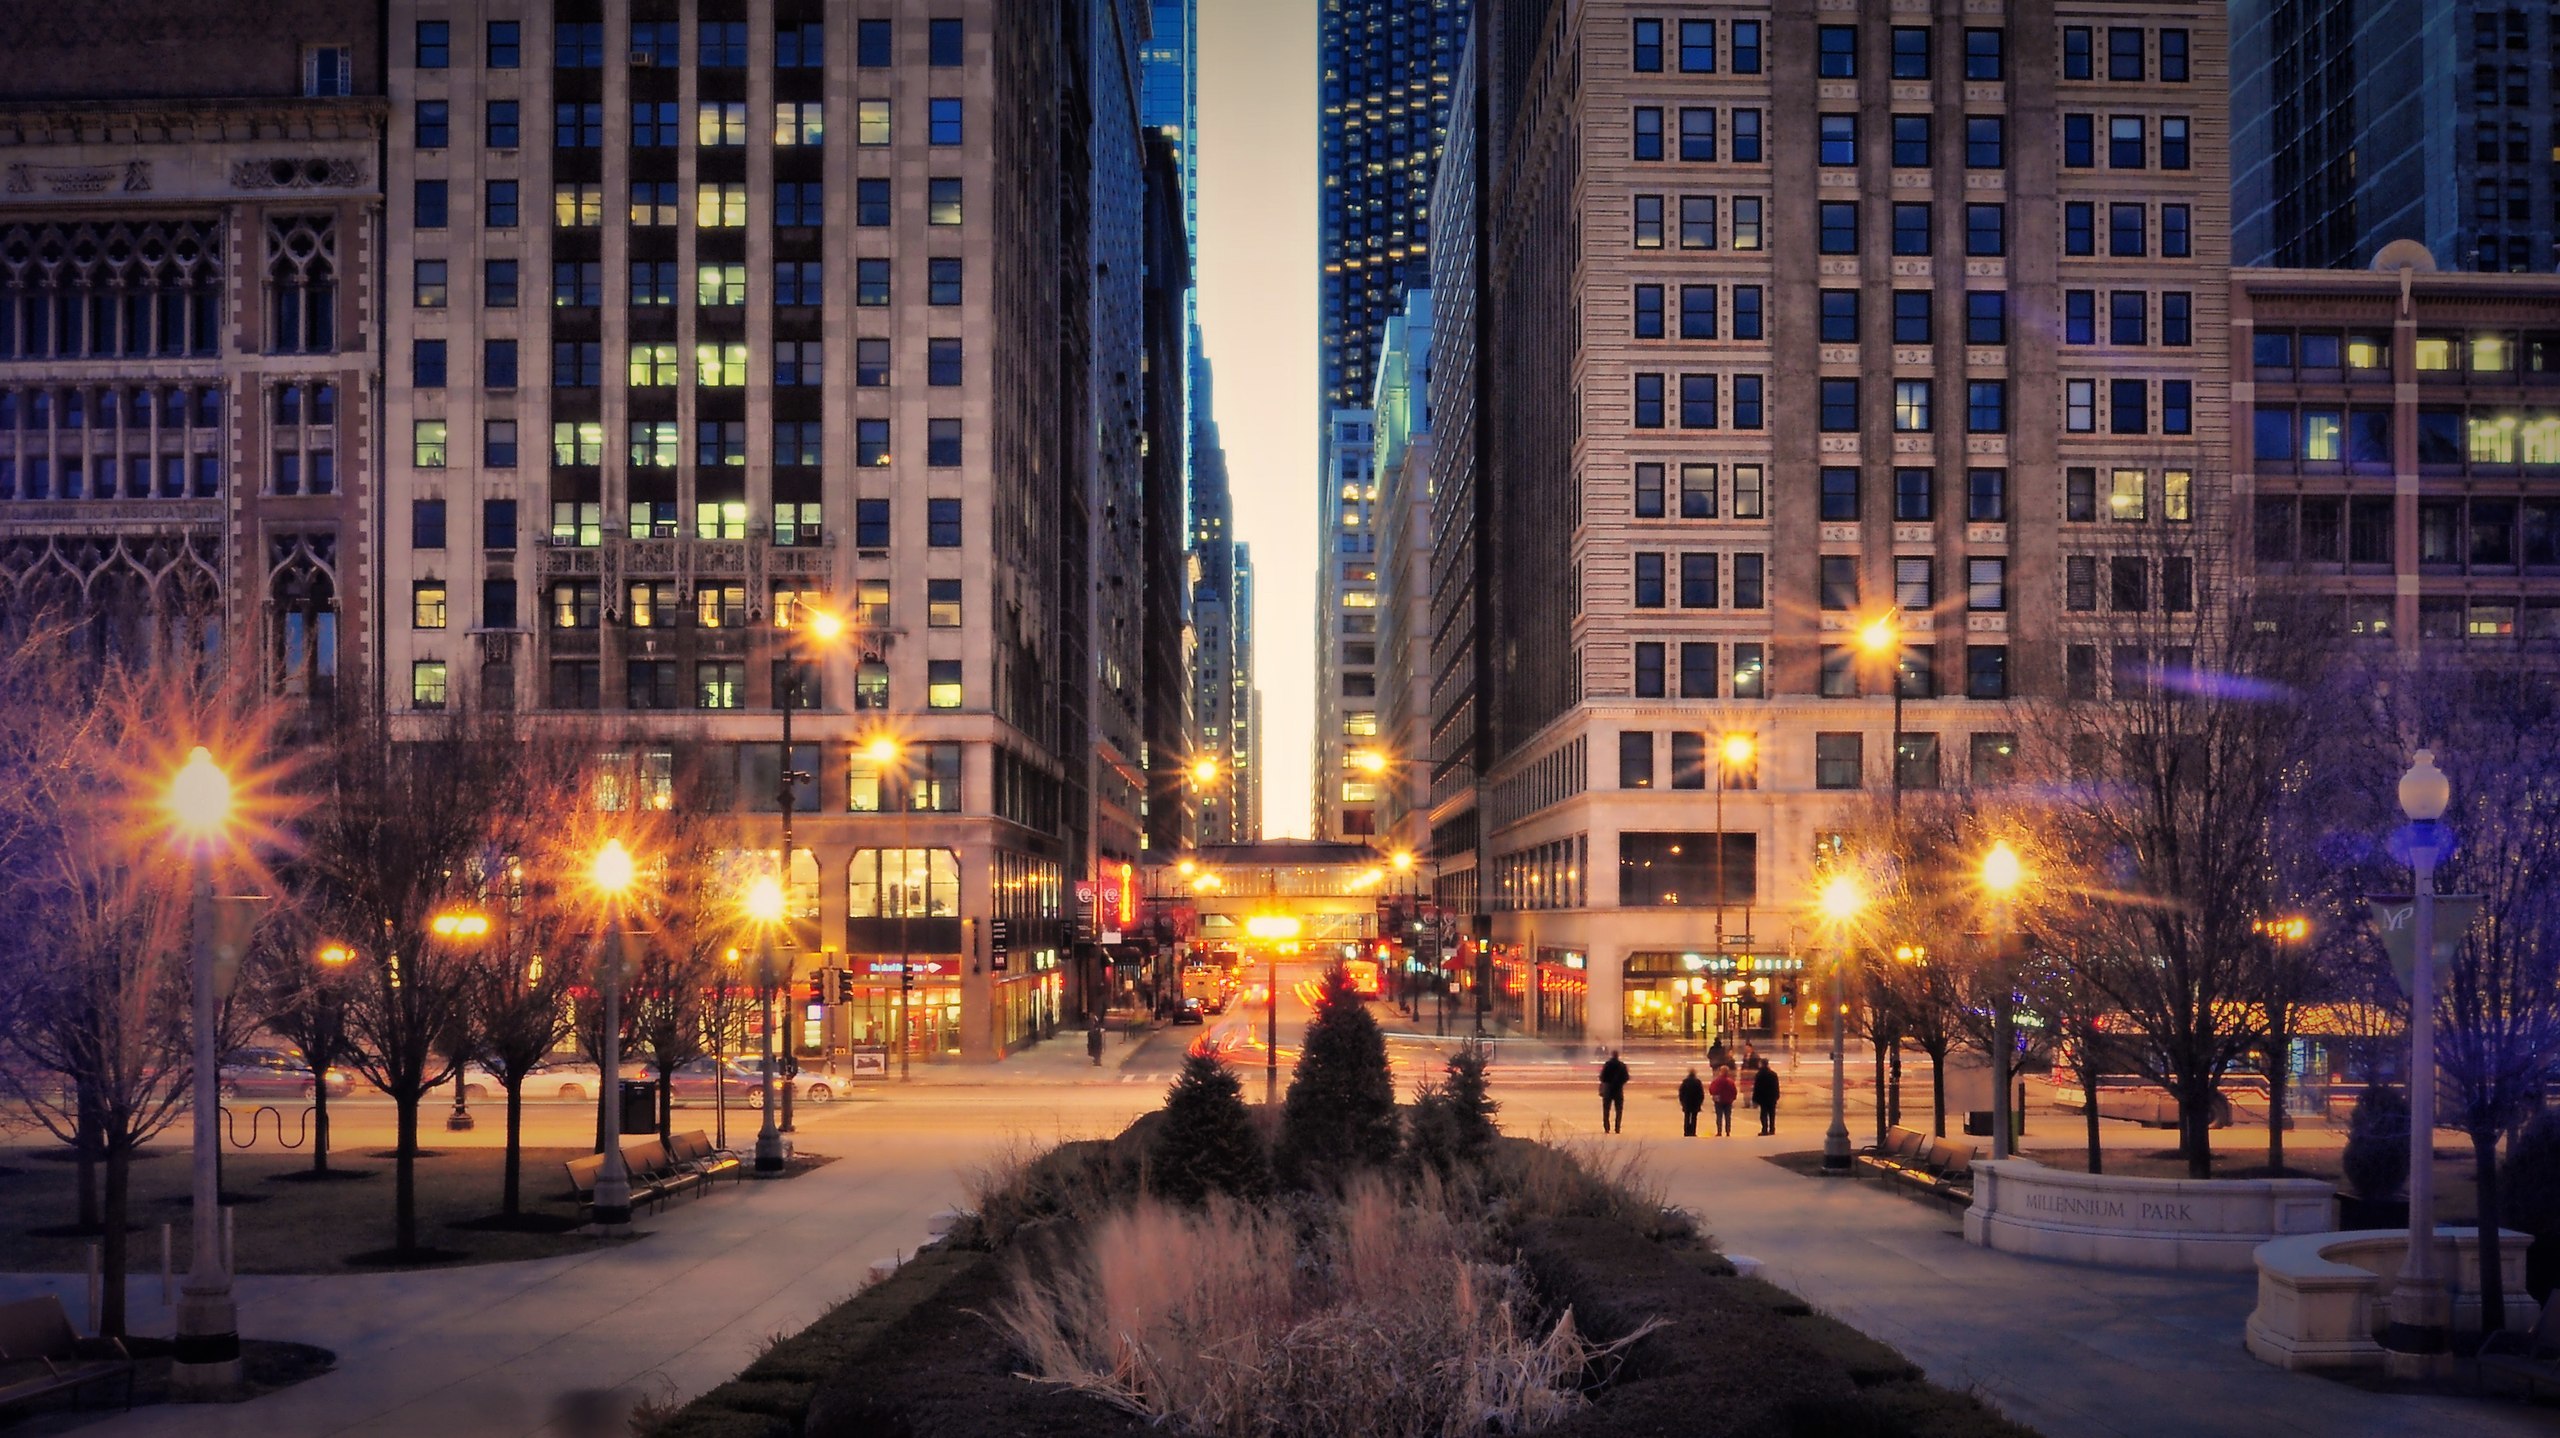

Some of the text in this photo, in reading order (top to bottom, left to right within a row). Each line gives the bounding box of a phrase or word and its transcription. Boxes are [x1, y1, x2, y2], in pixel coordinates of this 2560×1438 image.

[111, 505, 214, 519] ASSOCIATION
[2025, 1194, 2193, 1221] MILLENNIUM PARK
